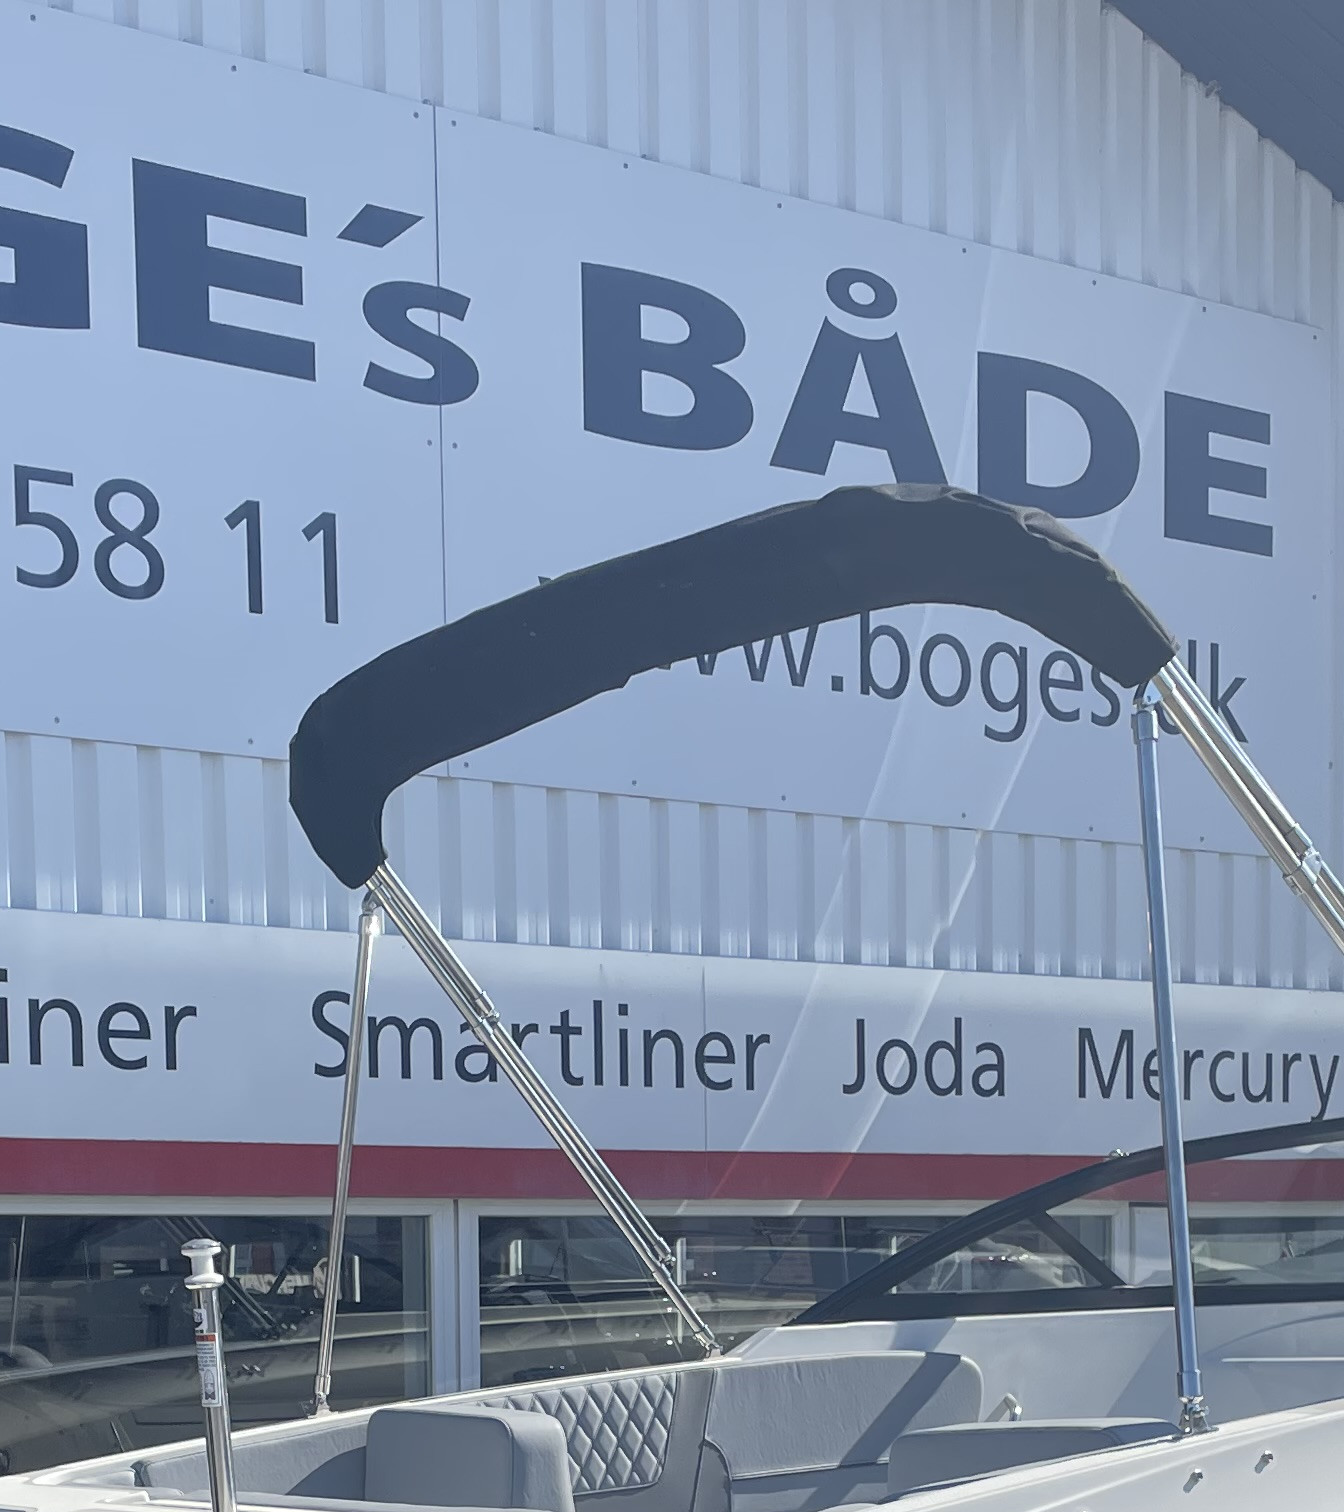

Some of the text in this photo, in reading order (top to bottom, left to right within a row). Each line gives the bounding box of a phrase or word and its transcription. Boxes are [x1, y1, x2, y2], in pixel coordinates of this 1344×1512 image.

[581, 267, 1273, 557] BÅDE
[13, 463, 165, 601] 58
[224, 499, 339, 625] 11
[311, 990, 771, 1092] Smartliner
[842, 1017, 1006, 1098] Joda
[1078, 1027, 1340, 1122] Mercury
